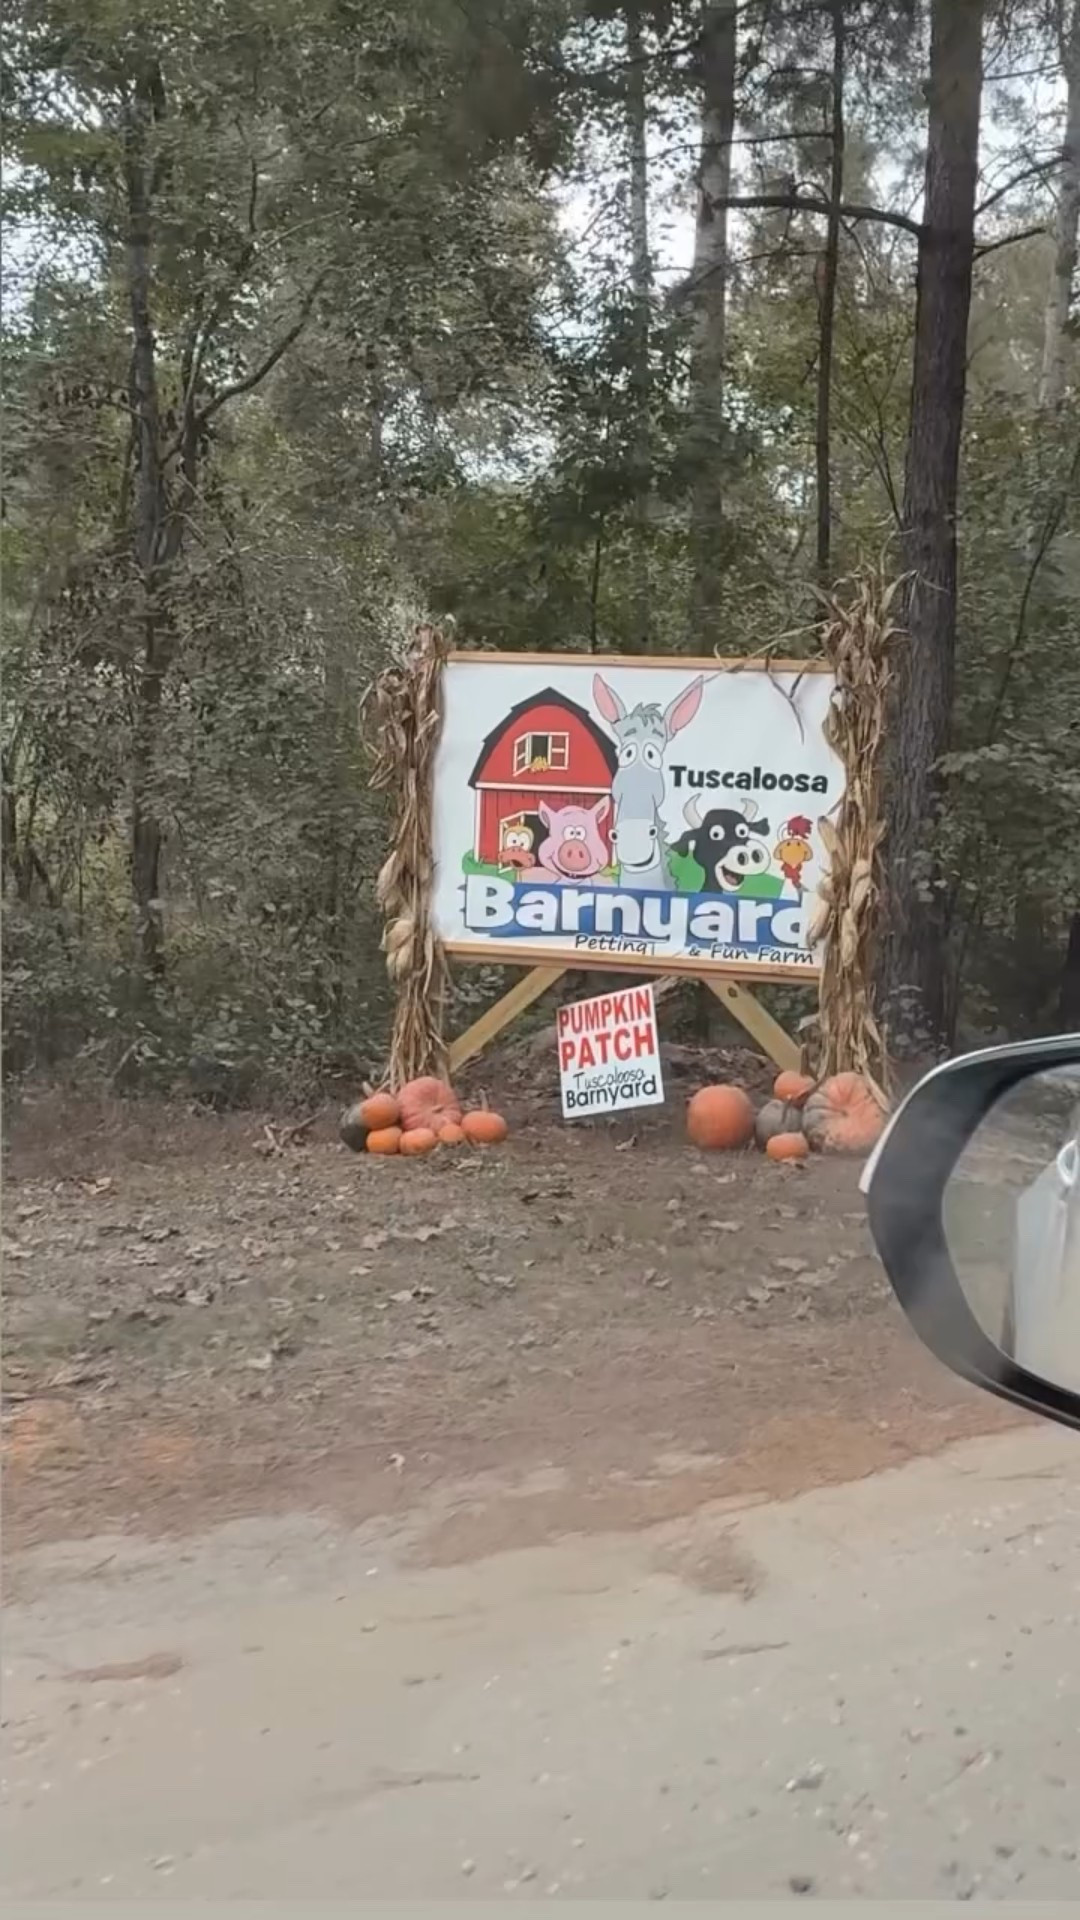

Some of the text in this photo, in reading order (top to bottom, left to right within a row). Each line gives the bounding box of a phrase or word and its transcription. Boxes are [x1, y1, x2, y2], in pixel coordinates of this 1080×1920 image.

[669, 765, 829, 794] Tuscaloosa
[464, 874, 814, 955] Barnyard
[575, 934, 814, 965] Petting & Fun Farm
[558, 989, 651, 1038] PUMPKIN
[561, 1022, 655, 1072] PATCH
[566, 1074, 657, 1109] Barnyard
